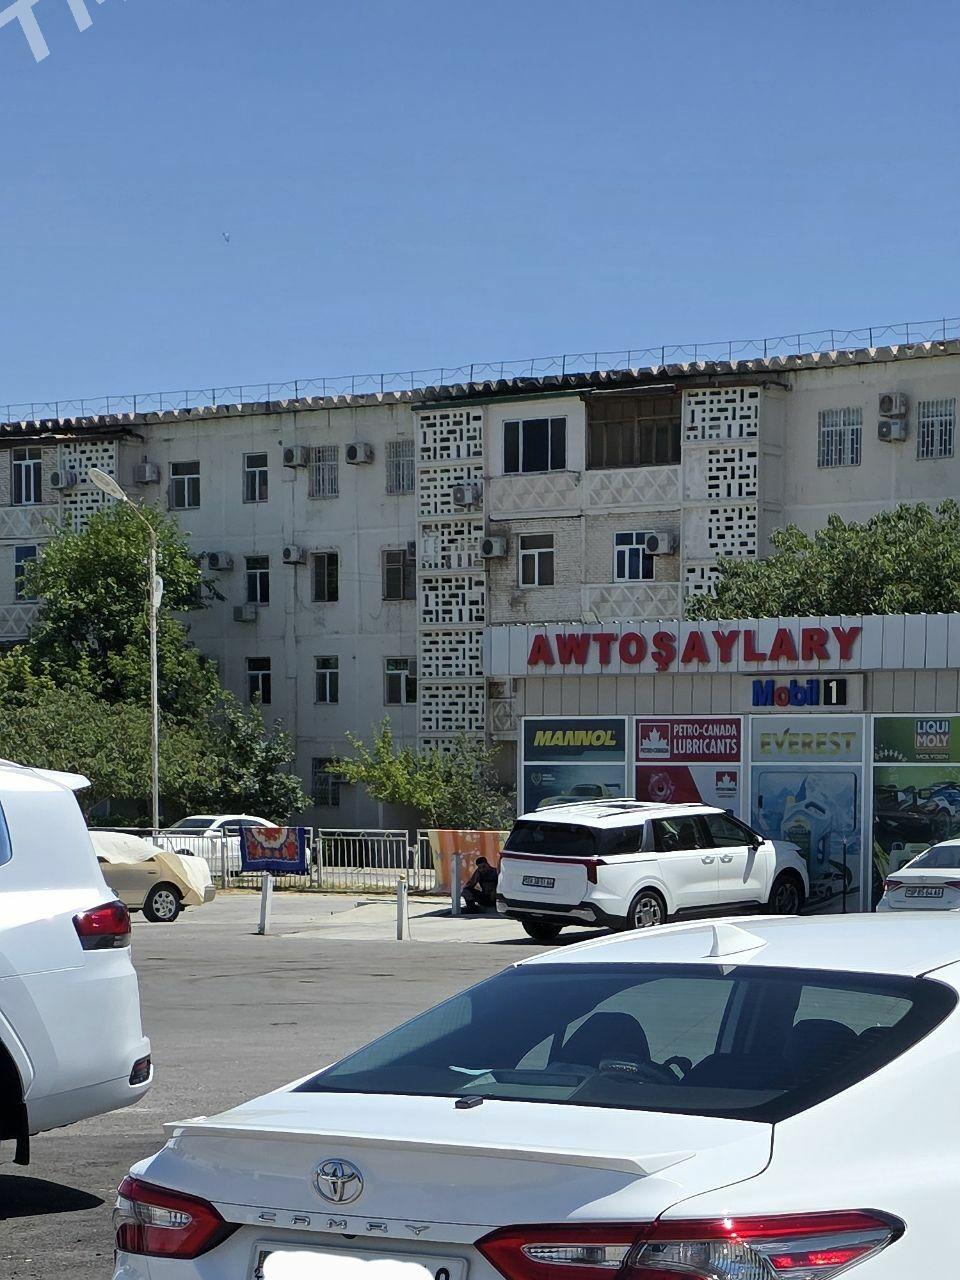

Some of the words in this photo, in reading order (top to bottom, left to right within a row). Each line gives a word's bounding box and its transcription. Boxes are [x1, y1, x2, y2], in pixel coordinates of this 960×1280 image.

[527, 626, 862, 672] AWTOŞAYLARY
[752, 679, 820, 707] Mobil
[829, 681, 837, 704] 1
[673, 724, 737, 736] PETRO-CANADA
[917, 721, 949, 734] LIQUI
[533, 730, 616, 746] MANNOL
[760, 731, 856, 755] EVEREST
[917, 734, 949, 747] MOLY
[673, 739, 737, 754] LUBRICANTS
[259, 1211, 430, 1235] CAMRY
